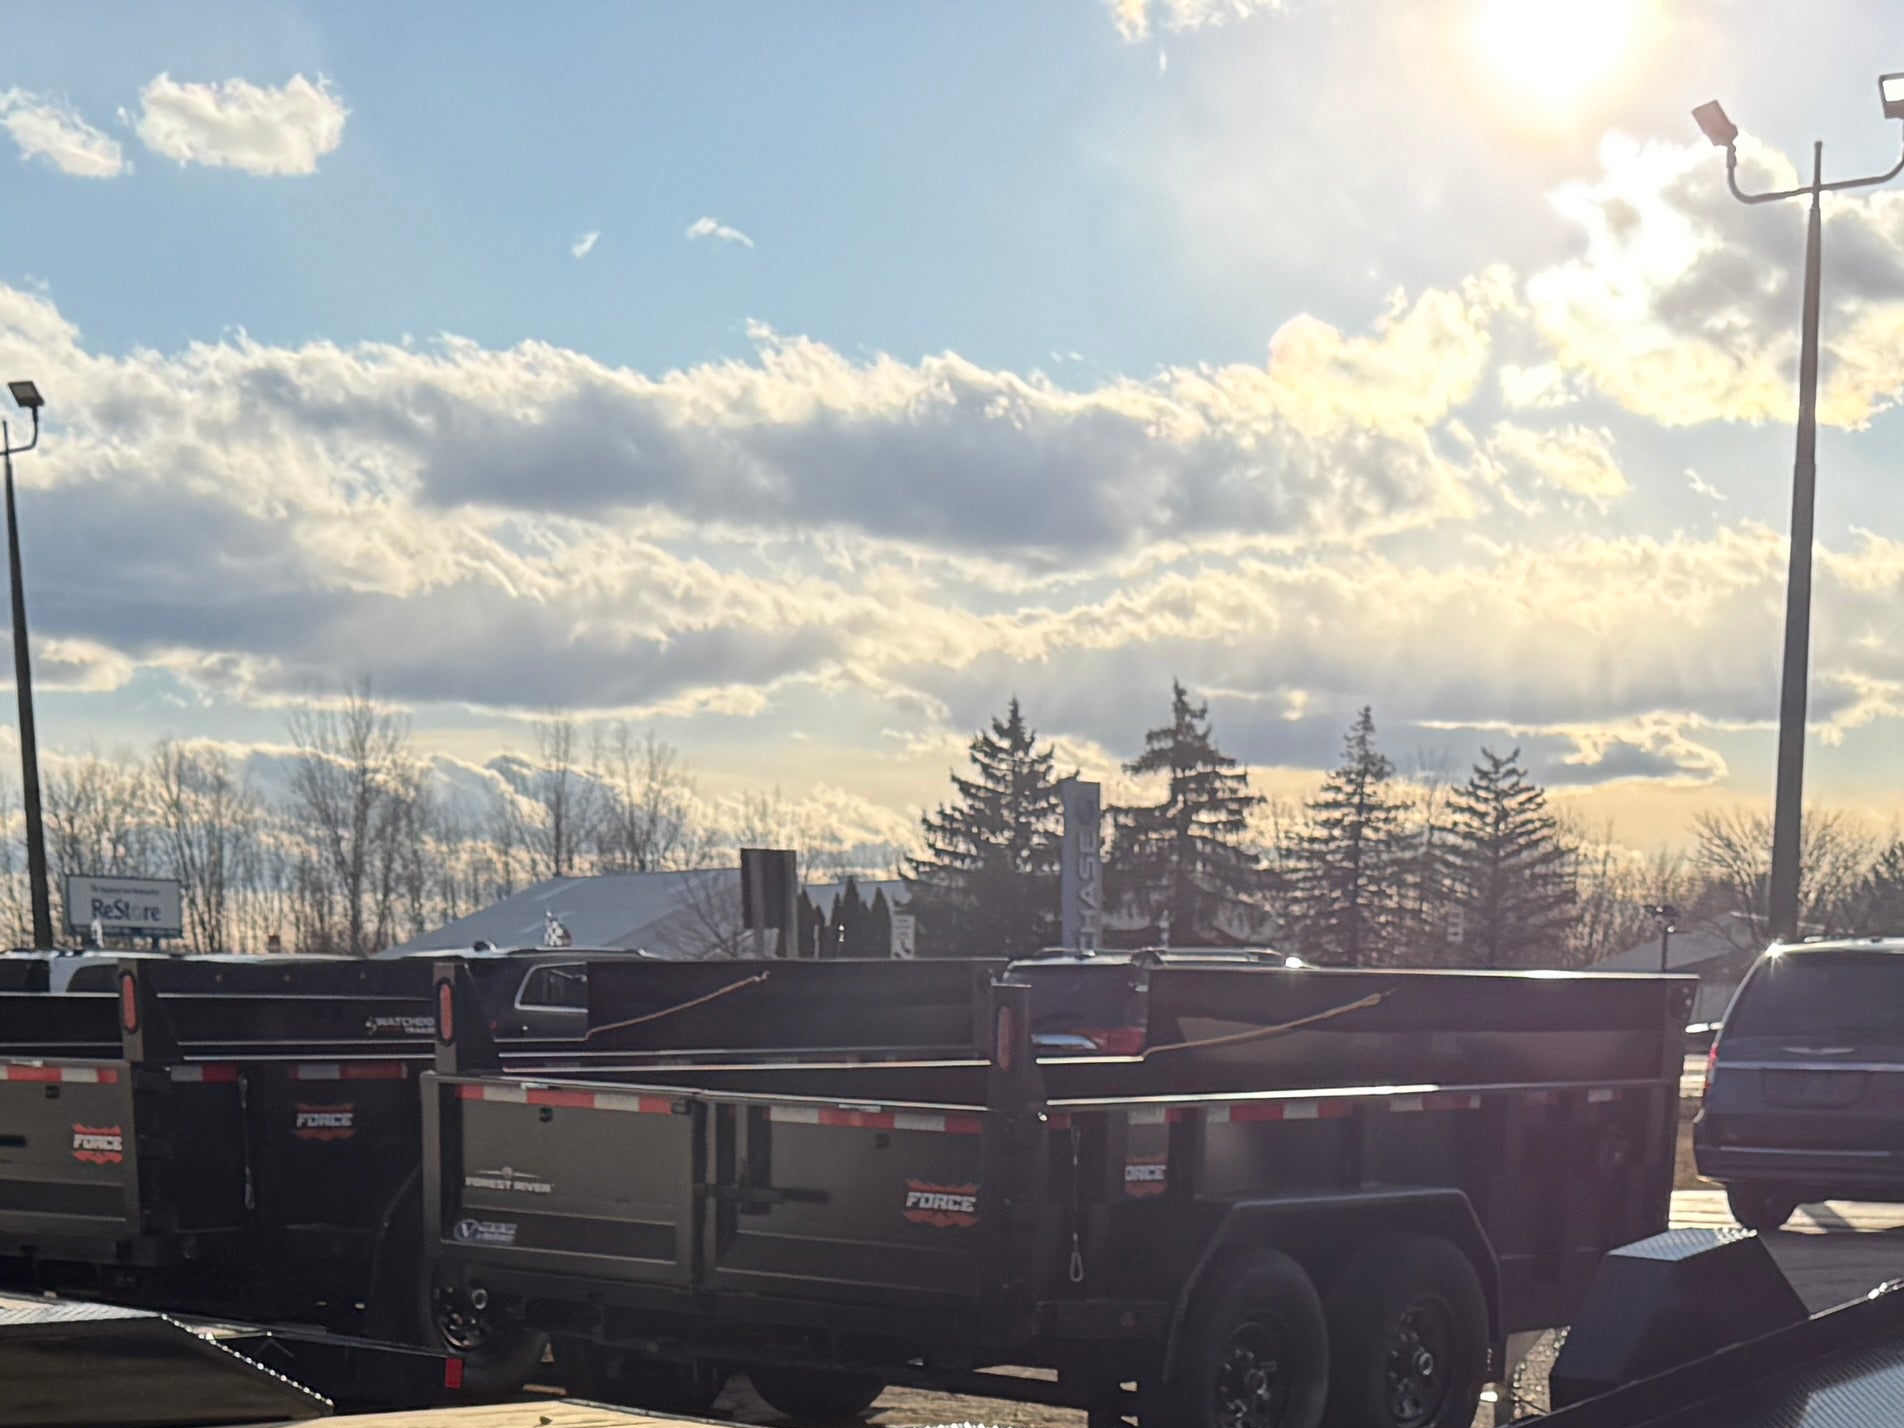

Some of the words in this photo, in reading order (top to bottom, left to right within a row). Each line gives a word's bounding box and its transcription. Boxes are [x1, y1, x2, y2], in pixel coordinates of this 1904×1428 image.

[296, 1113, 353, 1127] FORCE
[73, 1134, 122, 1150] FORCE
[1125, 1165, 1167, 1180] ORCE
[465, 1177, 512, 1189] FOREST
[514, 1181, 551, 1193] RIVER
[906, 1191, 976, 1212] FORCE
